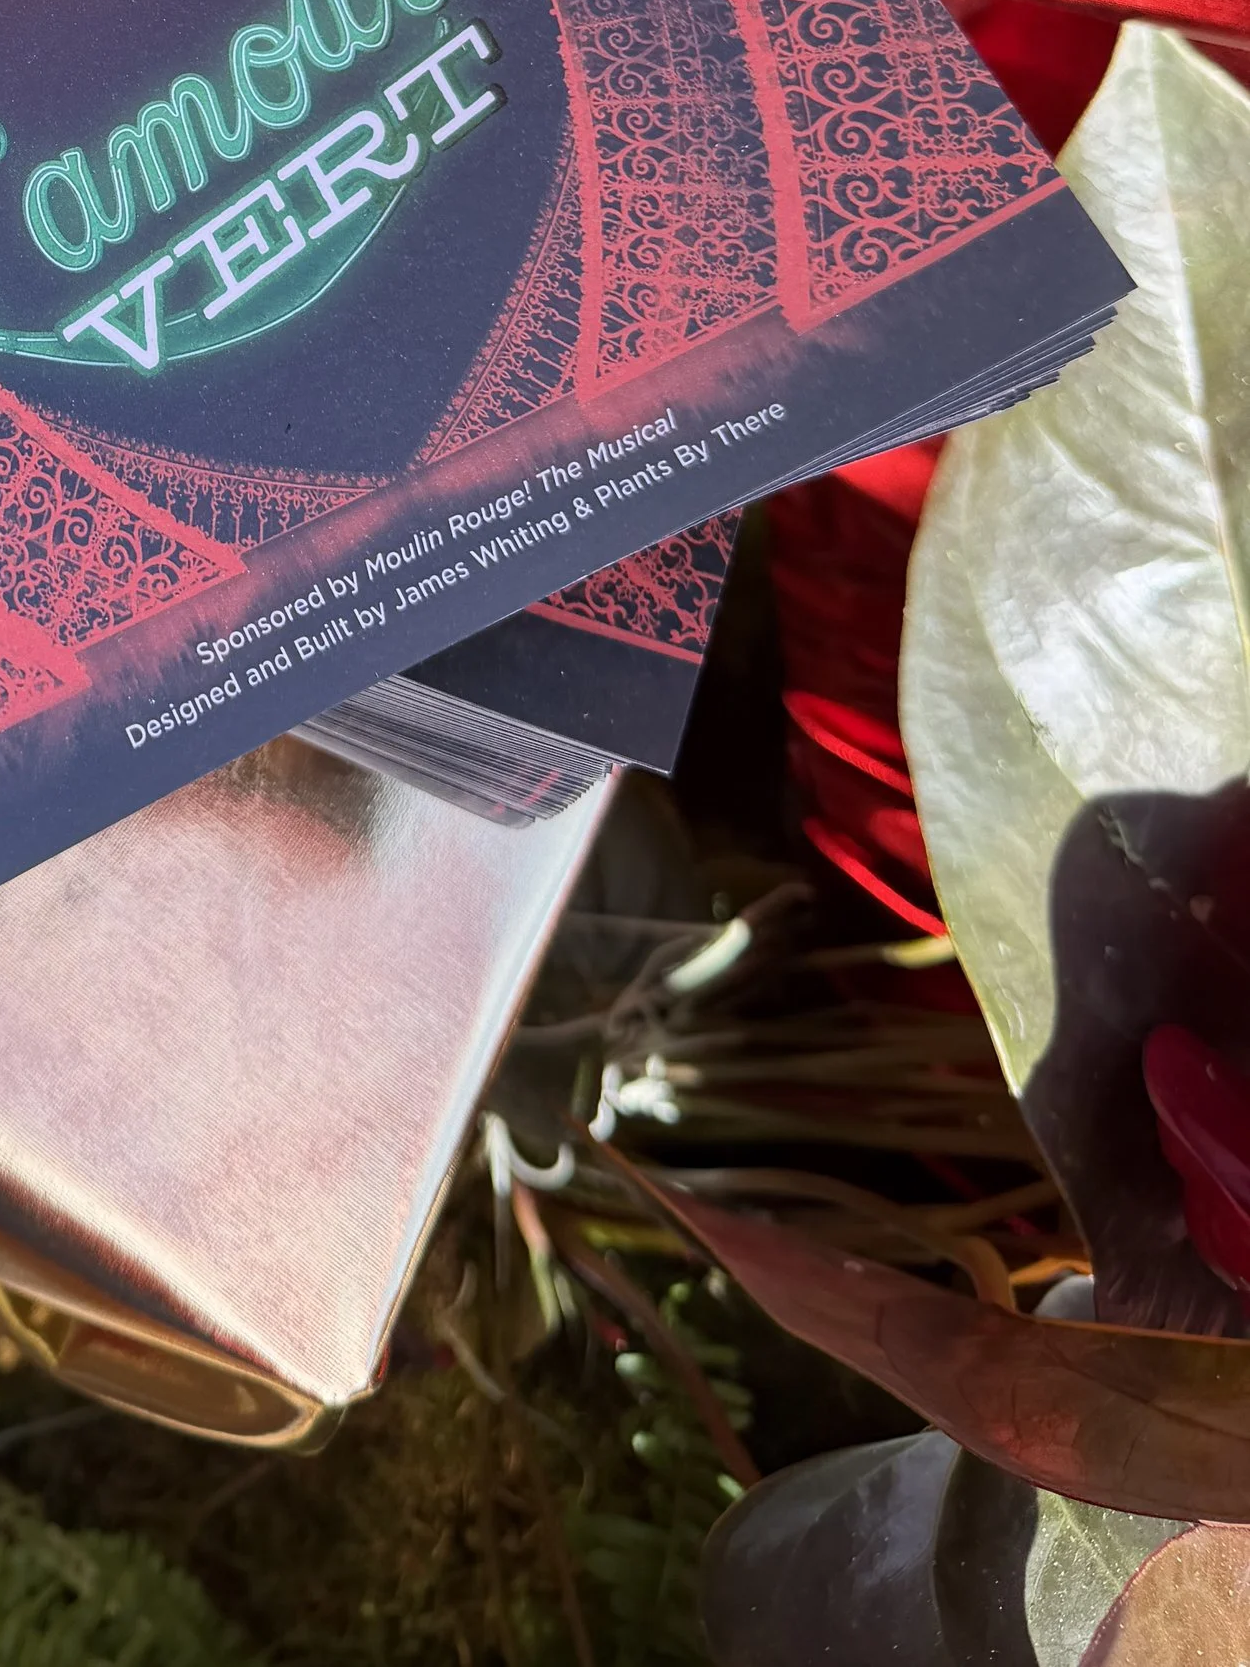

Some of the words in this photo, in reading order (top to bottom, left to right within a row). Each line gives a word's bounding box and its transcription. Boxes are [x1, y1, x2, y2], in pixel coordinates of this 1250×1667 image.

[62, 20, 502, 371] VERT
[125, 672, 242, 749] Designed
[247, 646, 292, 687] and
[294, 617, 353, 662] Built
[354, 601, 387, 632] by
[395, 560, 470, 612] James
[470, 510, 570, 569] Whiting
[572, 496, 594, 520] &
[594, 460, 672, 508] Plants
[673, 439, 710, 468] By
[710, 401, 786, 447] There
[196, 584, 326, 665] Sponsored
[326, 569, 360, 600] by
[365, 526, 444, 582] Moulin
[448, 480, 533, 538] Rouge!
[536, 459, 584, 493] The
[586, 407, 678, 470] Musical
